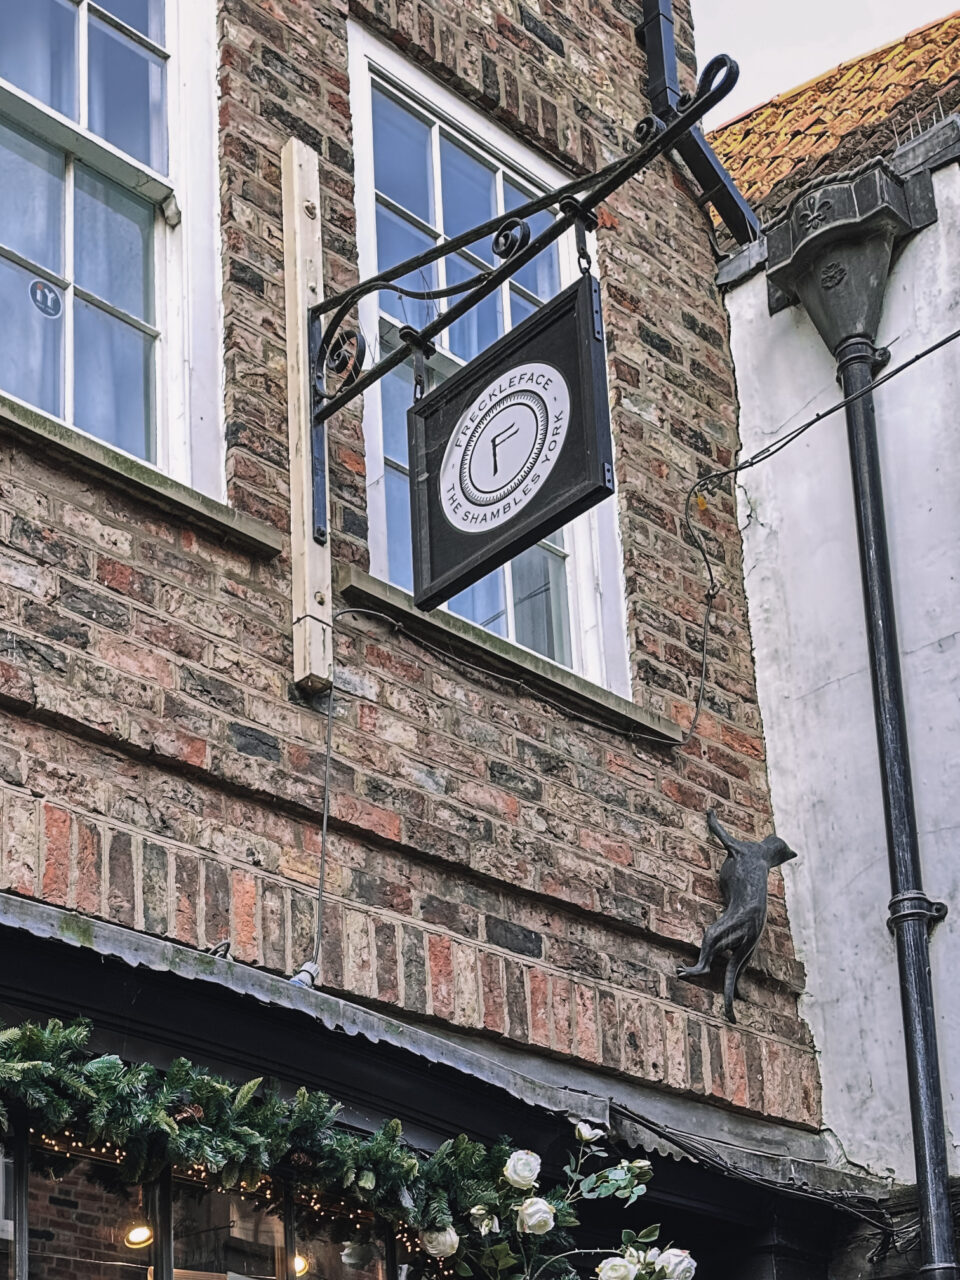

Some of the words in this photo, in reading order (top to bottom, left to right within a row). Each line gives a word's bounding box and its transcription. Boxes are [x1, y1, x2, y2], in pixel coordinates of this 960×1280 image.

[455, 372, 553, 449] FRECKLEFACE
[446, 482, 462, 515] THE
[461, 473, 541, 525] SHAMBLES
[541, 410, 564, 465] YORK
[490, 422, 520, 477] F
